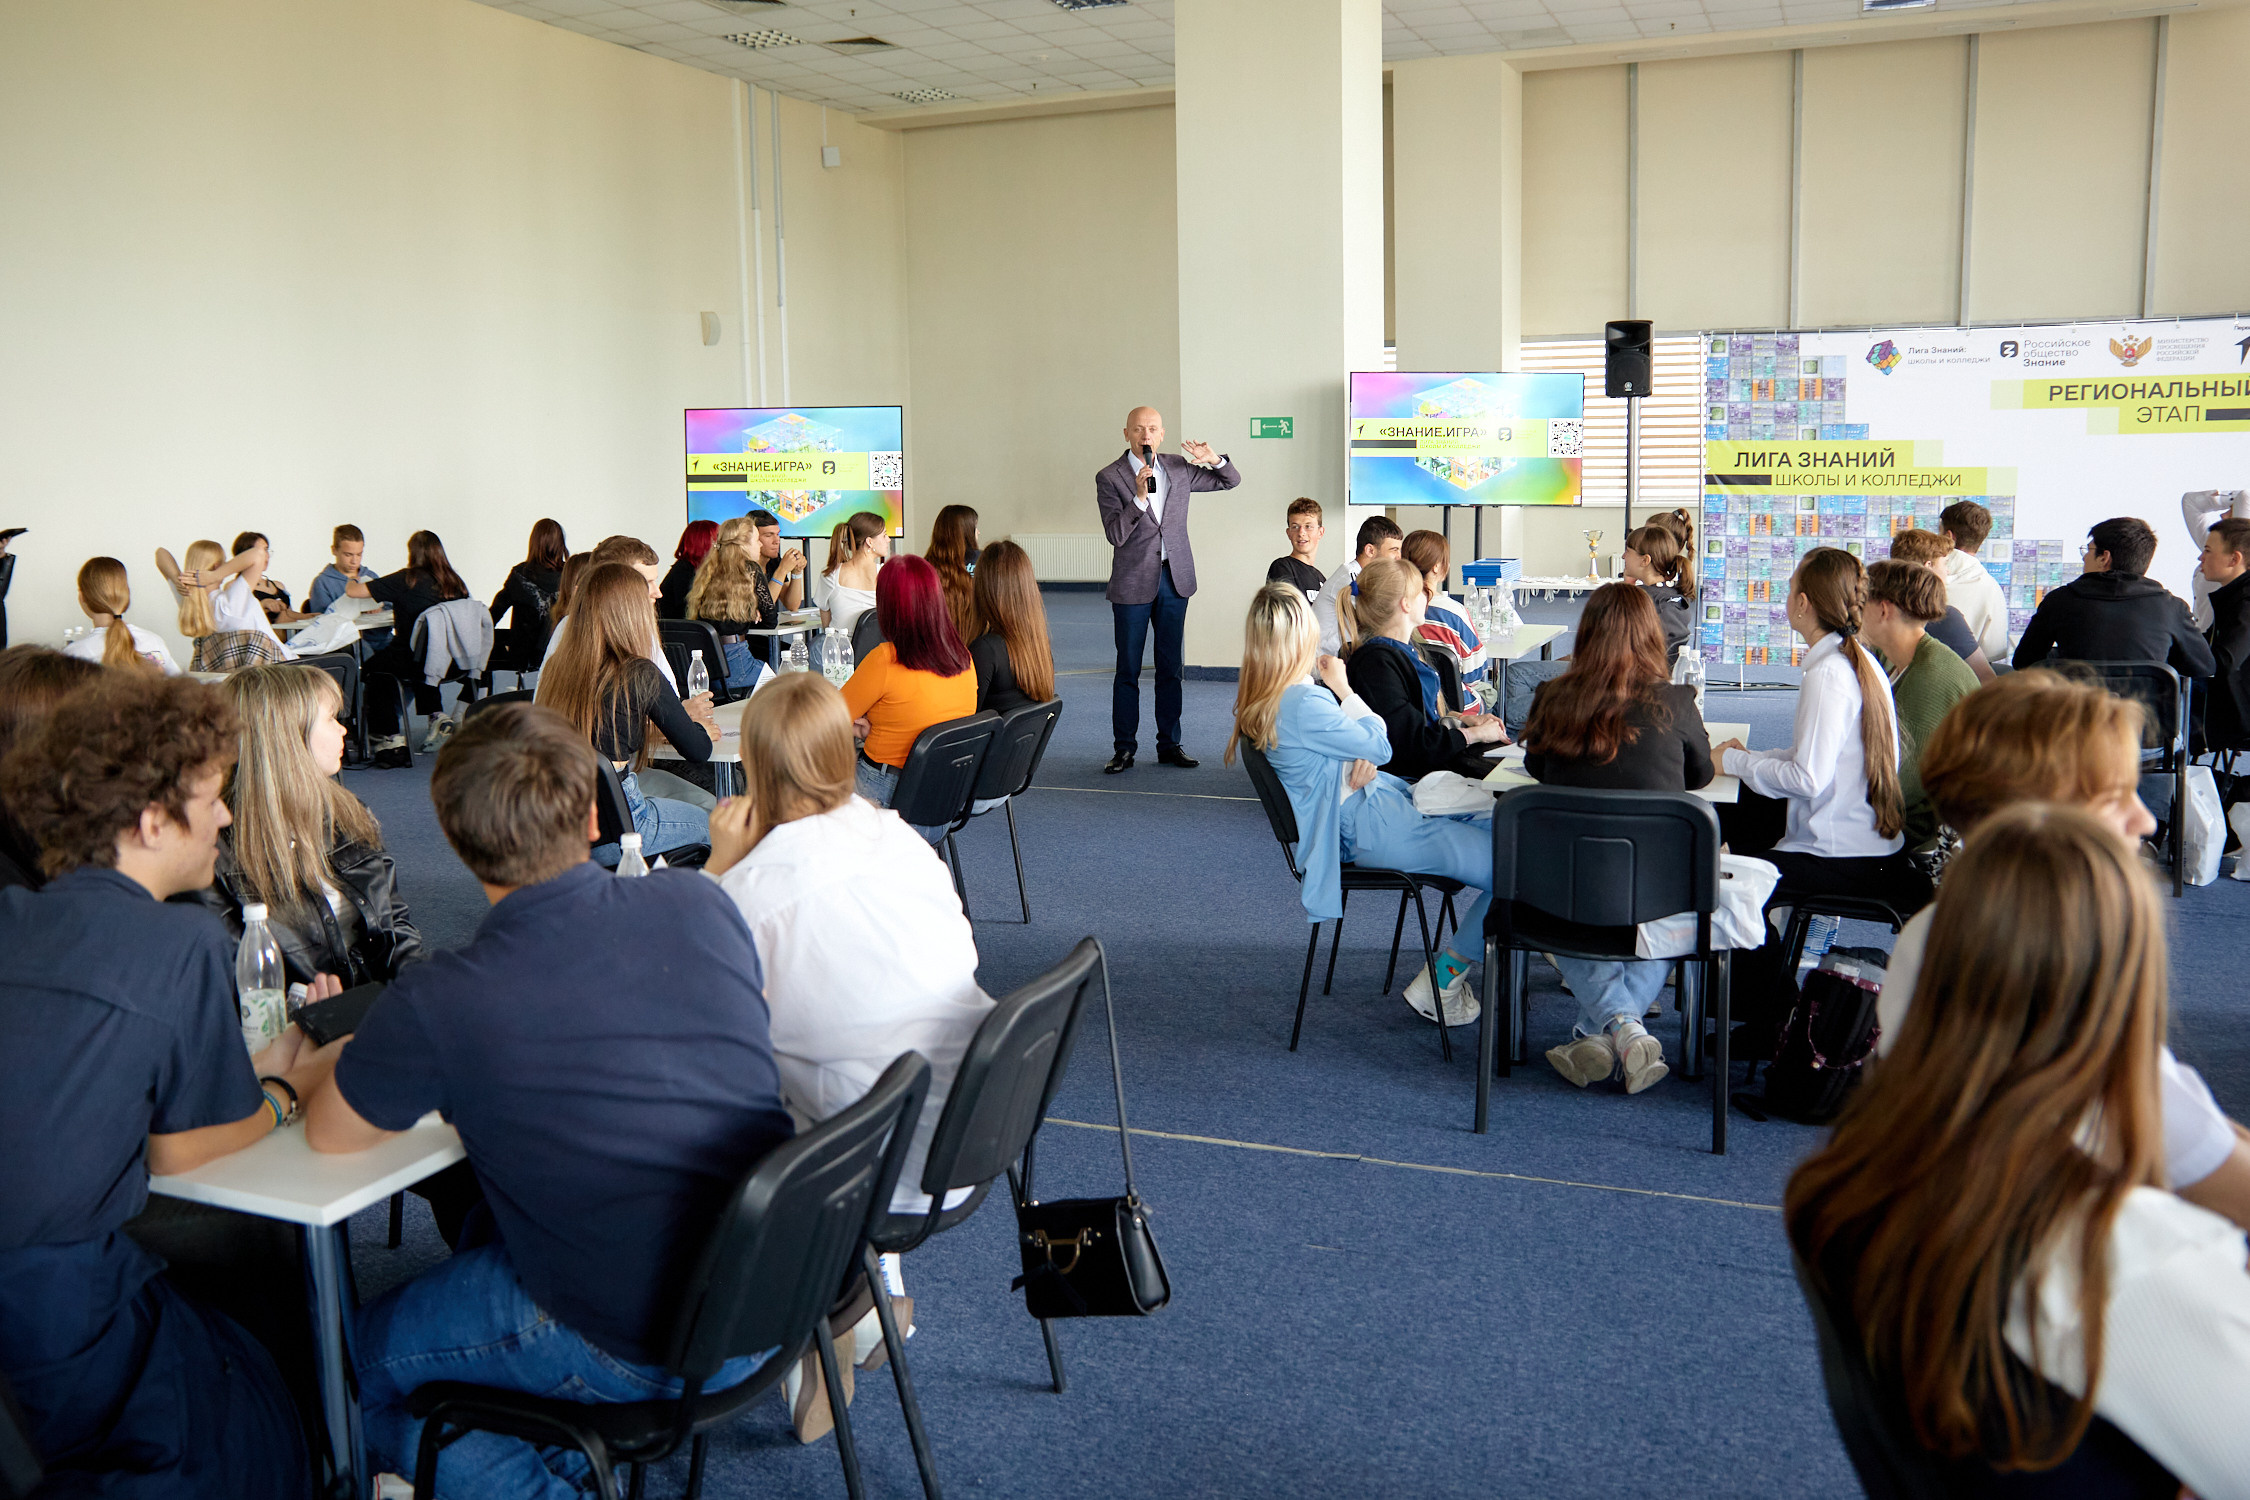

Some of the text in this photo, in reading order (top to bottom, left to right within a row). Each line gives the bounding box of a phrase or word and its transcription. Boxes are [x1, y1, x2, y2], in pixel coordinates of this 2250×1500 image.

[2023, 337, 2091, 349] Российское
[2156, 336, 2209, 344] МИНИСТЕРСТВО
[1908, 345, 1968, 355] Лига Знаний:
[2023, 349, 2079, 358] общество
[1907, 357, 1936, 365] школы
[1946, 356, 1991, 365] колледжи
[2023, 358, 2066, 367] Знание
[2136, 405, 2201, 423] ЭТАП
[1379, 426, 1487, 438] «ЗНАНИЕ.ИГРА»
[1734, 447, 1896, 468] ЛИГА ЗНАНИЙ
[713, 461, 812, 472] «ЗНАНИЕ.ИГРА»
[1775, 473, 1962, 489] ШКОЛЫ И КОЛЛЕДЖИ
